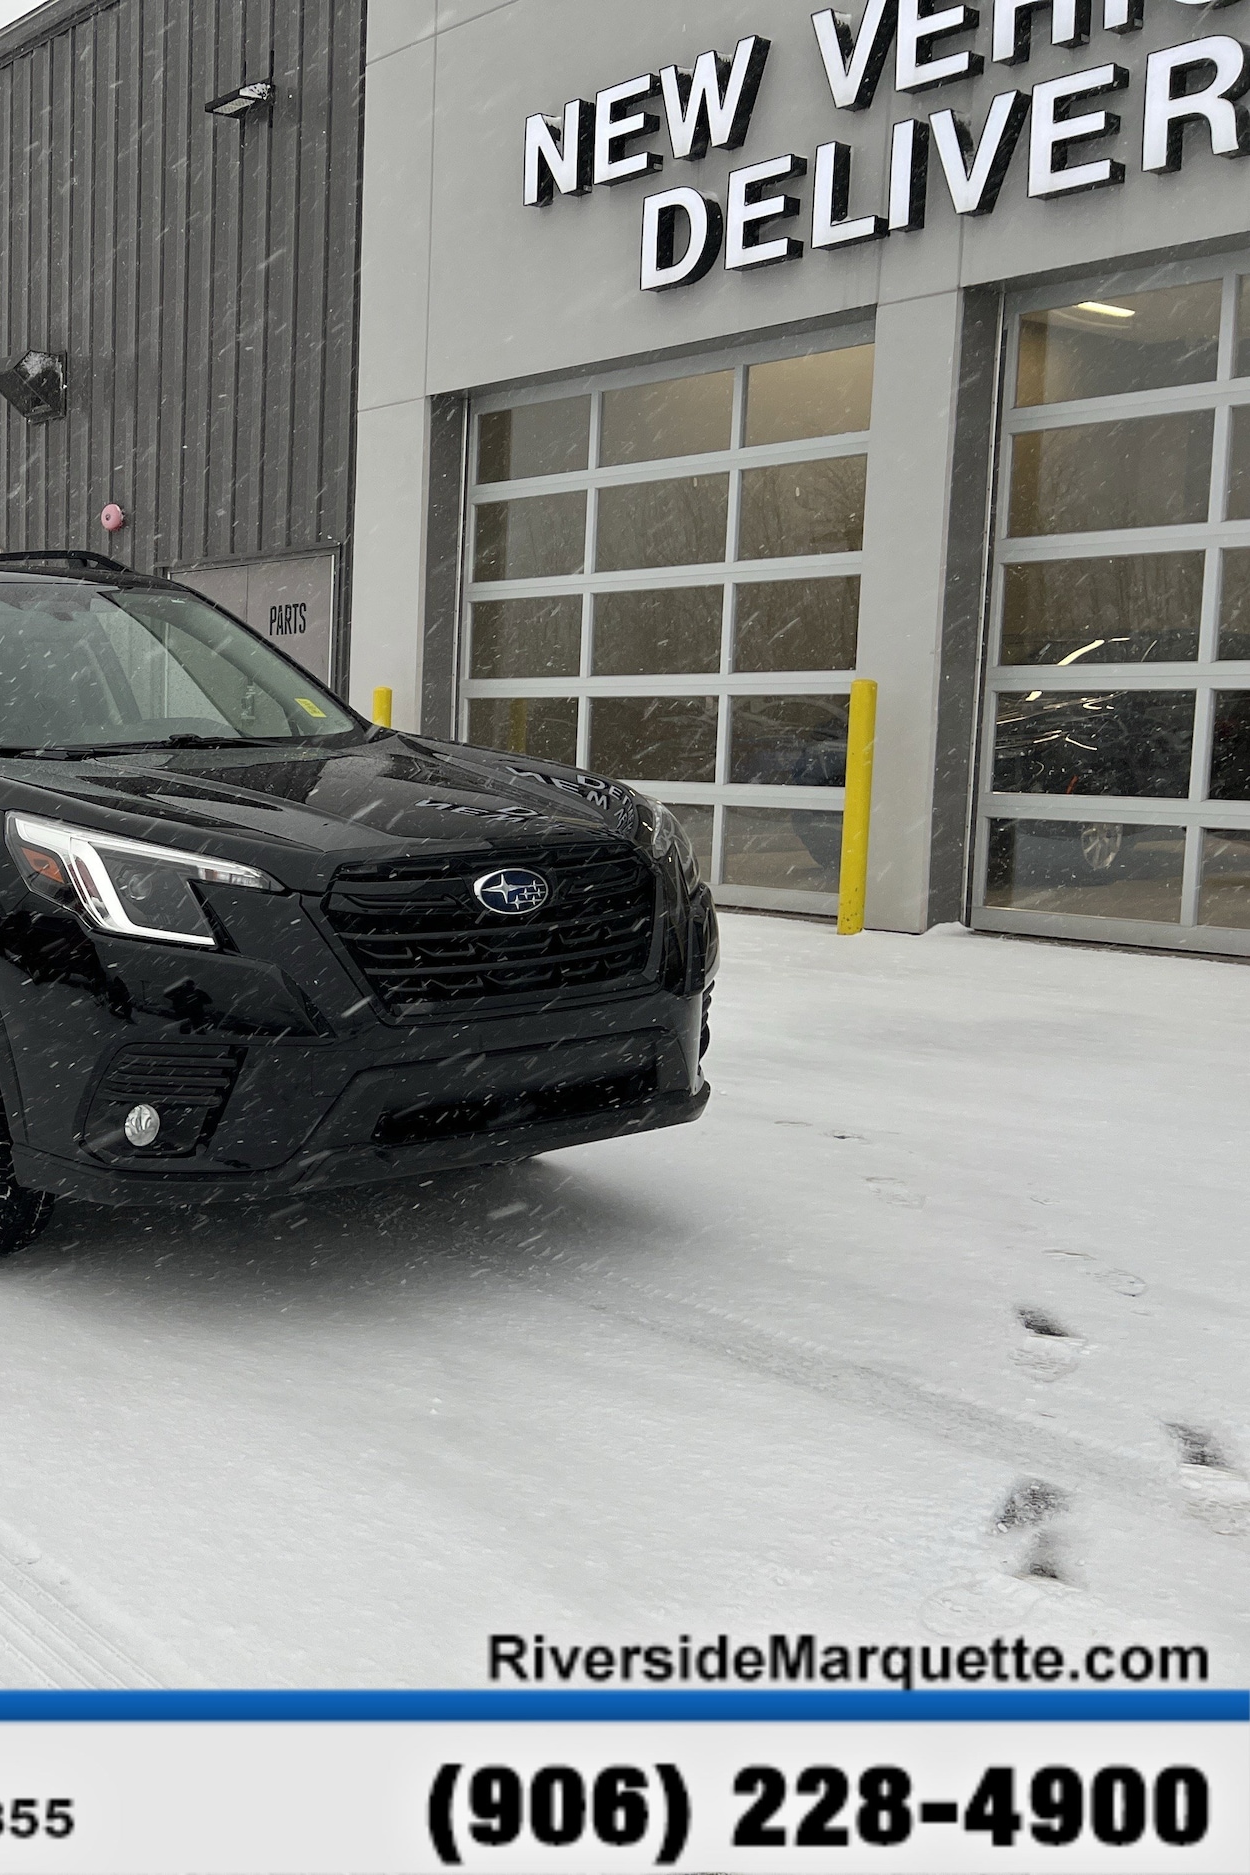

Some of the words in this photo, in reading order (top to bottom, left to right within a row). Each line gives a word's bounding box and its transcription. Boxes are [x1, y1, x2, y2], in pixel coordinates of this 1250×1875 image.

[523, 35, 770, 206] NEW
[640, 35, 1250, 291] DELIVER
[269, 602, 307, 635] PARTS
